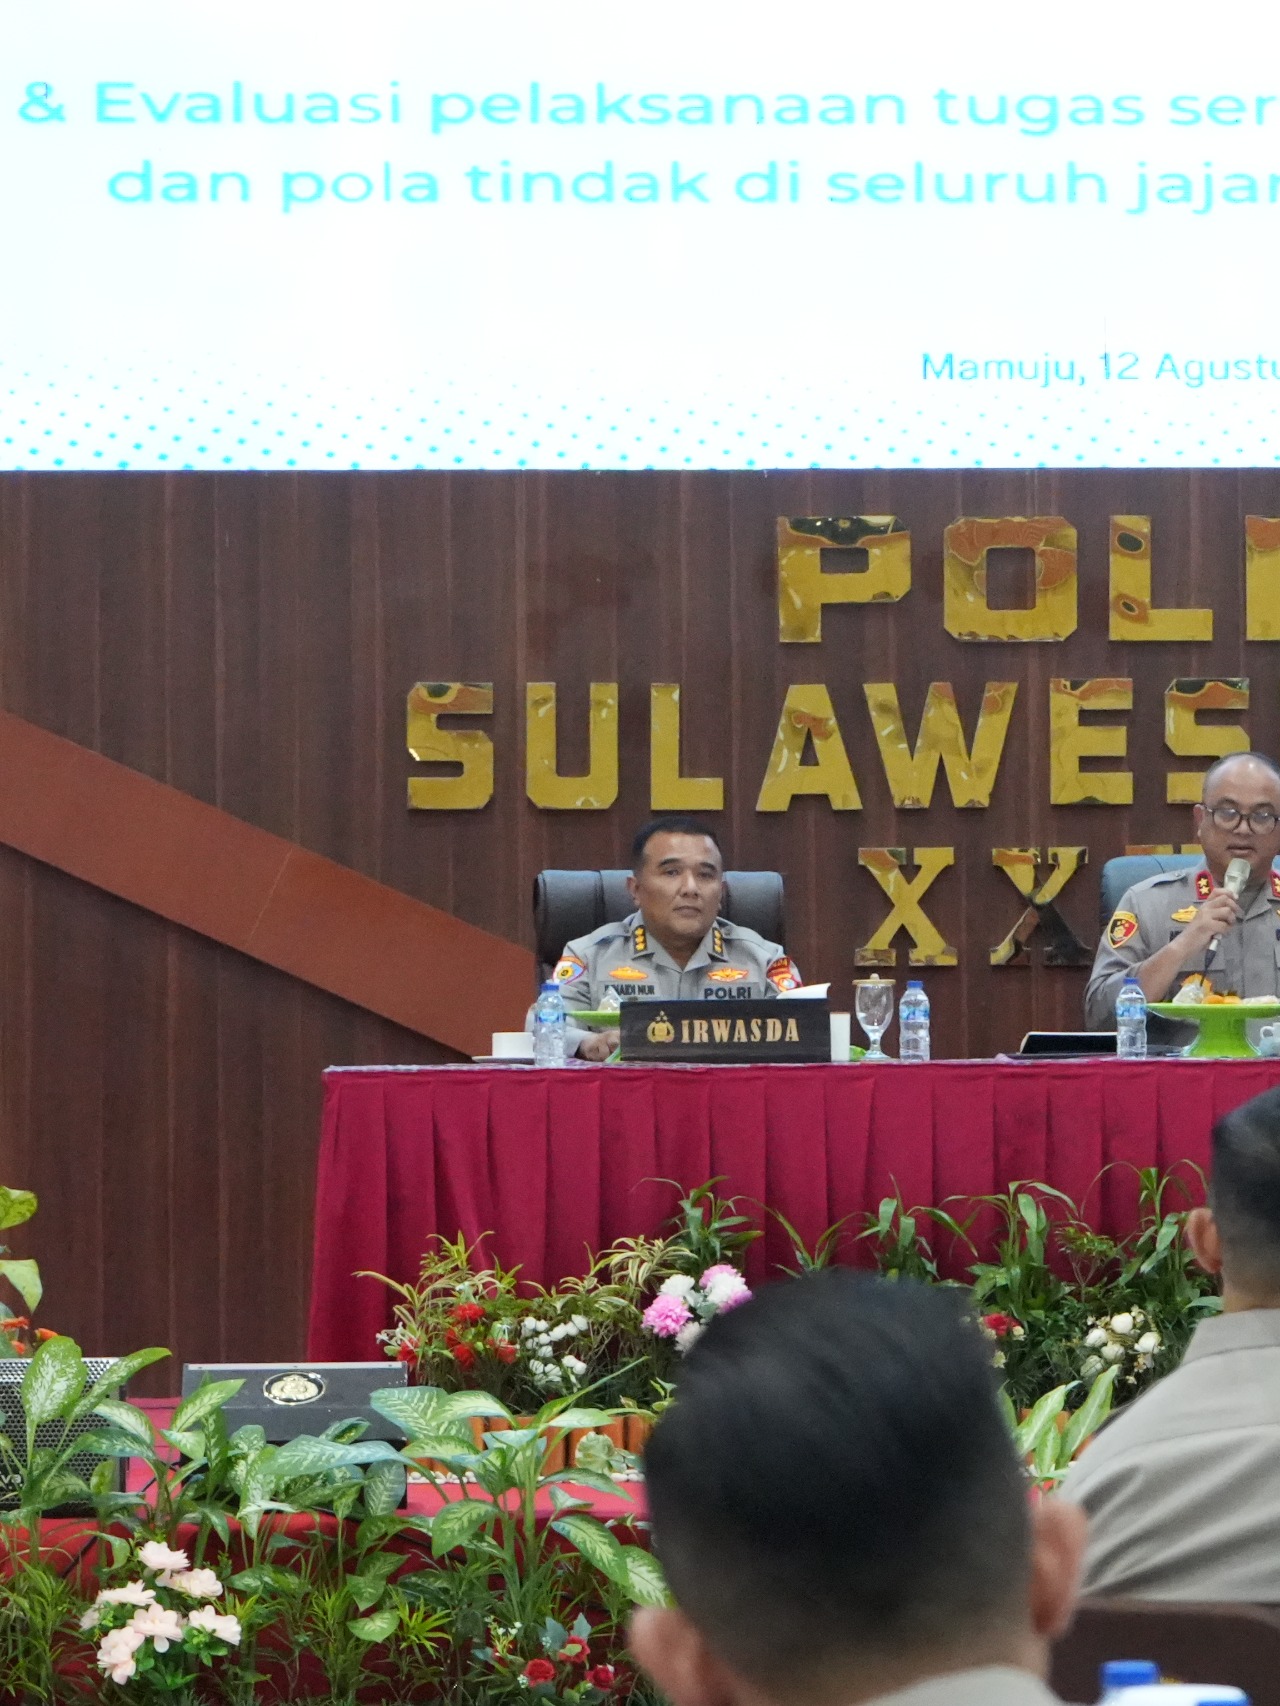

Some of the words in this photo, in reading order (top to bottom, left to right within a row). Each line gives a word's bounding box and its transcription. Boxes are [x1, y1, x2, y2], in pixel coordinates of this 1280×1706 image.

[17, 81, 67, 125] &
[95, 80, 402, 126] Evaluasi
[431, 81, 905, 136] pelaksanaan
[933, 87, 1145, 137] tugas
[107, 159, 251, 204] dan
[282, 160, 440, 214] pola
[464, 160, 710, 204] tindak
[735, 159, 801, 204] di
[827, 160, 1108, 205] seluruh
[922, 352, 1087, 388] Mamuju,
[1099, 352, 1140, 381] 12
[704, 986, 752, 999] POLRI
[681, 1018, 800, 1043] IRWASDA
